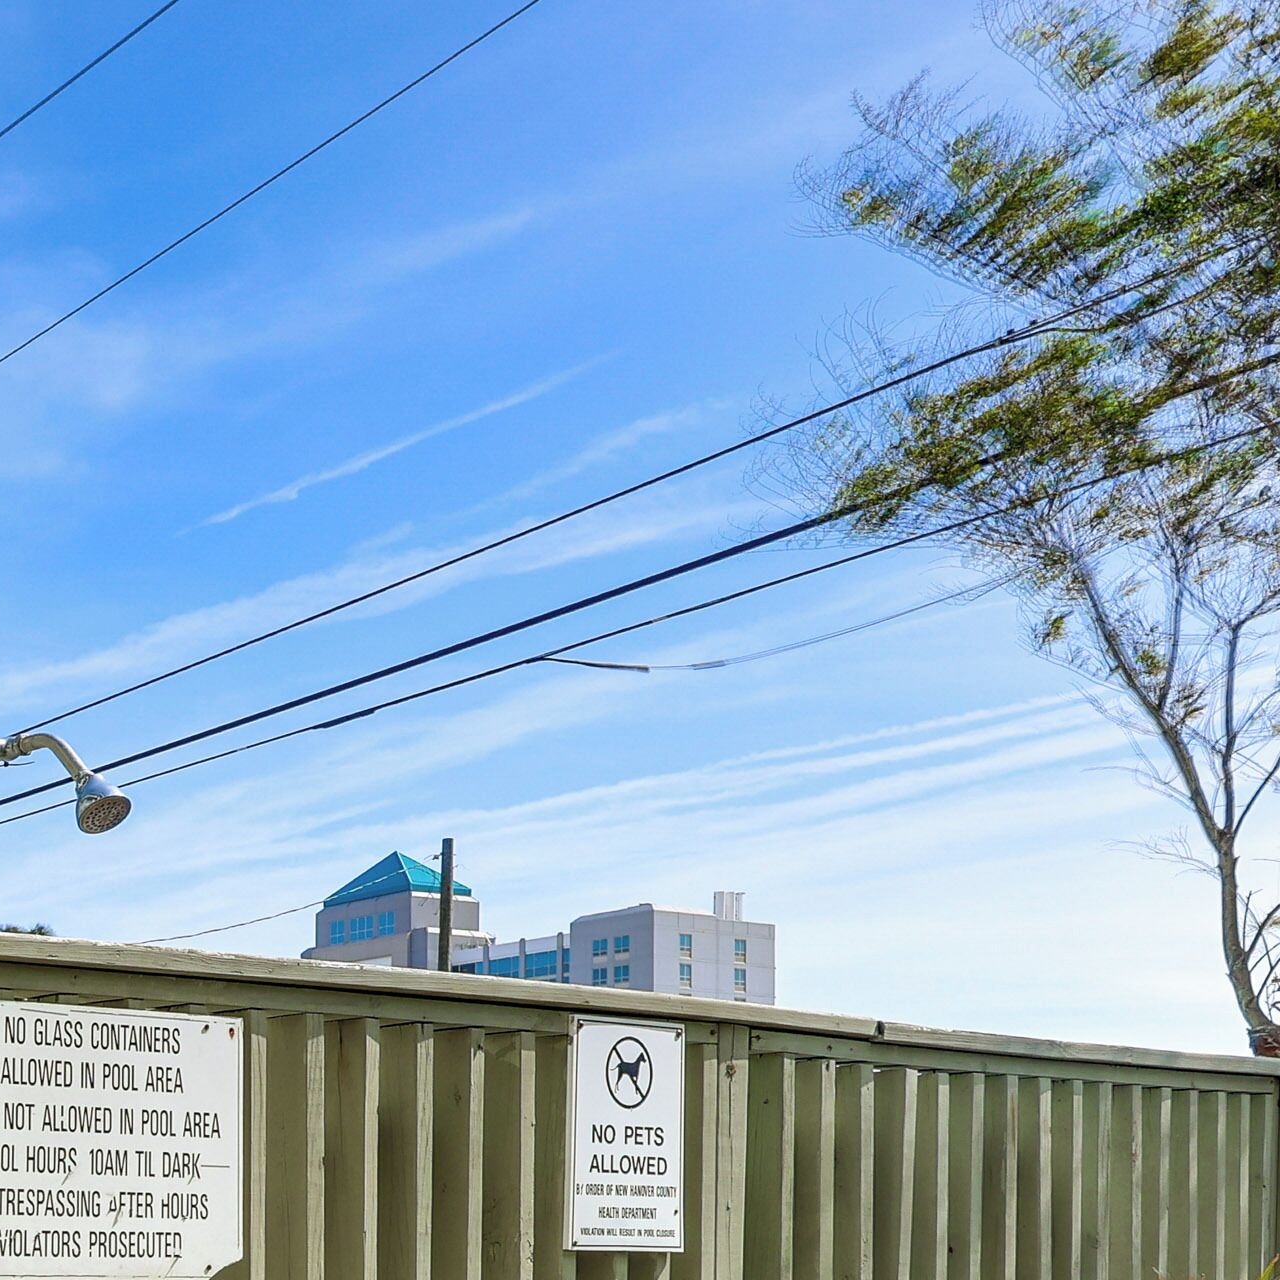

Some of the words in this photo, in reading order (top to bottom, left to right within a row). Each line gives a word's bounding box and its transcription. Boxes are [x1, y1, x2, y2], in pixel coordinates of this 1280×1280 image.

[5, 1017, 25, 1044] NO
[35, 1019, 82, 1048] GLASS
[92, 1023, 180, 1054] CONTAINERS
[1, 1058, 72, 1087] ALLOWED
[81, 1062, 94, 1088] IN
[103, 1064, 138, 1090] POOL
[146, 1067, 183, 1093] AREA
[5, 1103, 34, 1130] NOT
[42, 1105, 111, 1133] ALLOWED
[121, 1109, 133, 1134] IN
[142, 1110, 175, 1136] POOL
[183, 1112, 220, 1138] AREA
[592, 1125, 615, 1144] NO
[625, 1126, 663, 1146] PETS
[27, 1146, 76, 1173] HOURS
[90, 1149, 127, 1176] 10AM
[136, 1151, 155, 1176] TIL
[163, 1152, 200, 1178] DARK
[590, 1154, 667, 1175] ALLOWED
[576, 1184, 584, 1195] BY
[586, 1184, 604, 1195] ORDER
[606, 1184, 613, 1195] OF
[615, 1185, 628, 1196] NEW
[630, 1185, 654, 1197] HANOVER
[656, 1186, 677, 1197] COUNTY
[110, 1192, 153, 1217] AFTER
[162, 1193, 208, 1219] HOURS
[599, 1207, 619, 1218] HEALTH
[622, 1207, 657, 1219] DEPARTMENT
[0, 1230, 80, 1257] VIOLATORS
[90, 1232, 181, 1258] PROSECUTED
[580, 1228, 604, 1236] VIOLATION
[607, 1228, 617, 1236] WILL
[644, 1229, 654, 1237] POOL
